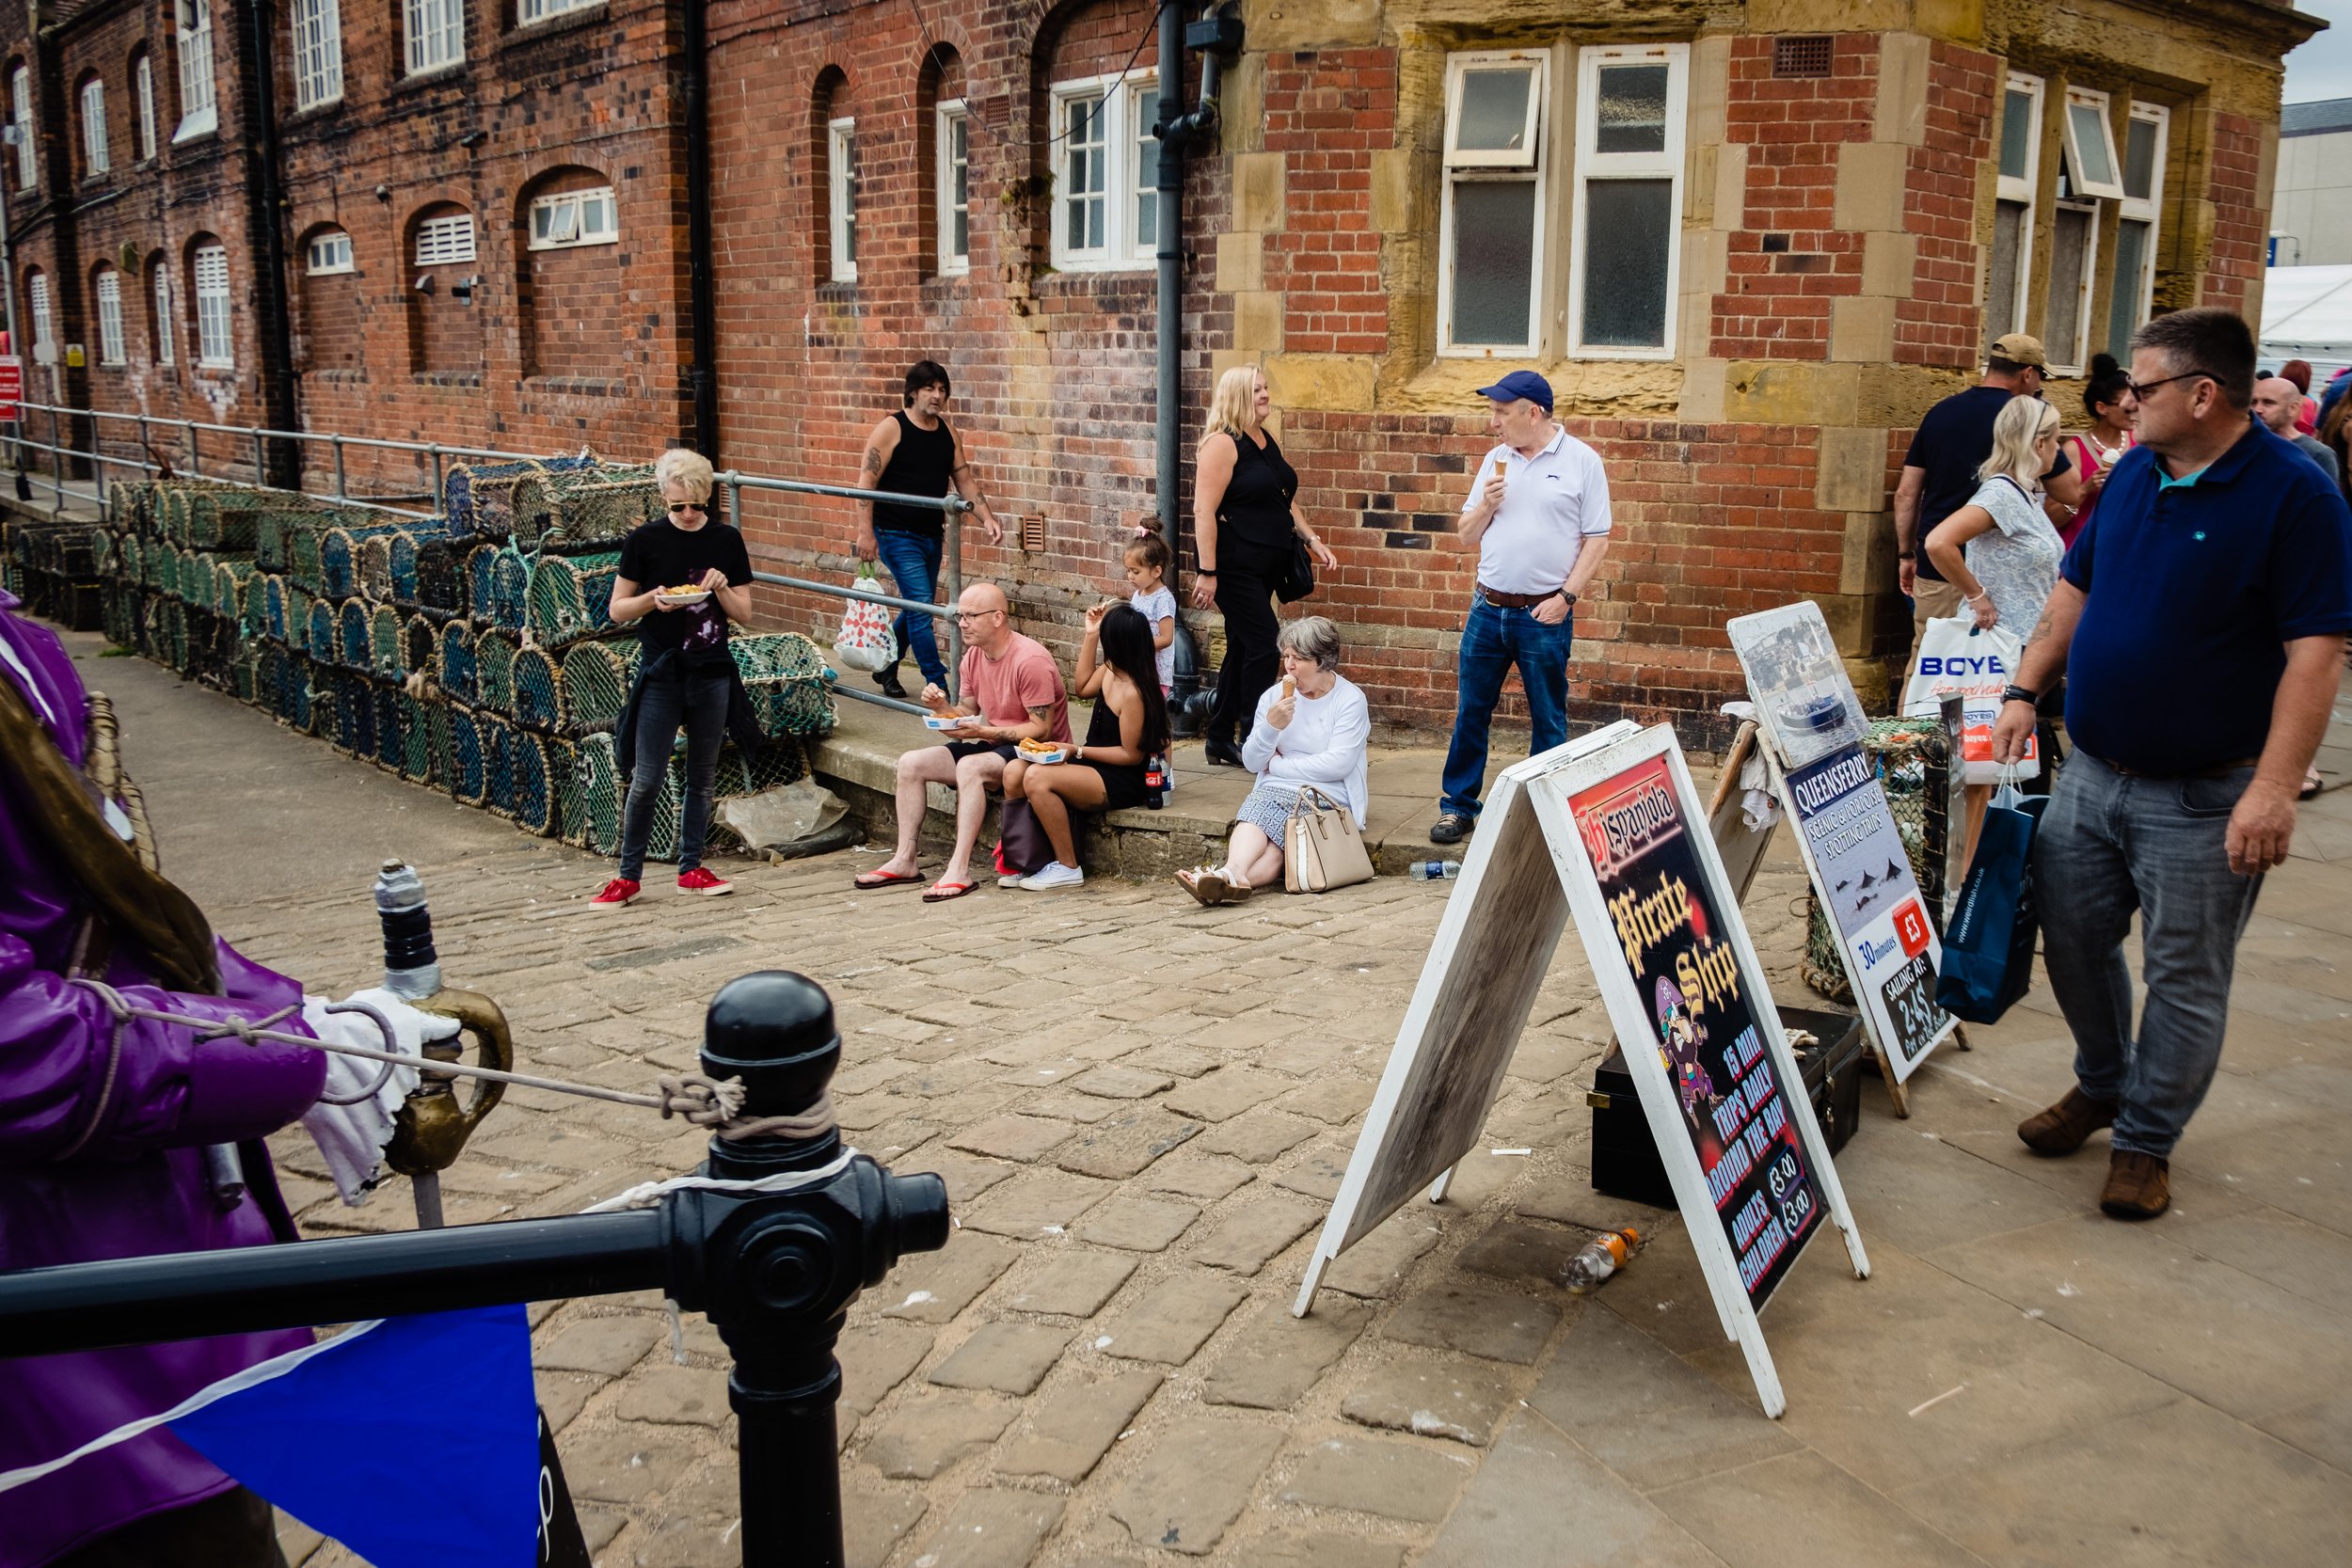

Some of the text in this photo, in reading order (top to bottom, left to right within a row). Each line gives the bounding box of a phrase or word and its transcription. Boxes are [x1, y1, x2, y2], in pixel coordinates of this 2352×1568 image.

[1920, 656, 2006, 676] BOYE
[1795, 752, 1871, 816] QUEENSFERRY
[1808, 787, 1882, 842] SCENIC & PORPOISE
[1824, 813, 1883, 861] SPOTTING TRIPS
[1609, 871, 1692, 978] Pirate
[1905, 912, 1921, 942] £3
[1958, 867, 1985, 943] www.weirdfish.co.uk
[1676, 936, 1740, 1021] Ship
[1858, 935, 1897, 970] 30 minutes
[1886, 956, 1928, 1002] SAILING AT:
[1723, 1024, 1764, 1081] 15 MIN
[1711, 1059, 1775, 1144] TRIPS DAILY
[1705, 1095, 1788, 1210] AROUND THE BAY
[1731, 1189, 1769, 1252] ADULTS
[1739, 1215, 1788, 1292] CHILDREN
